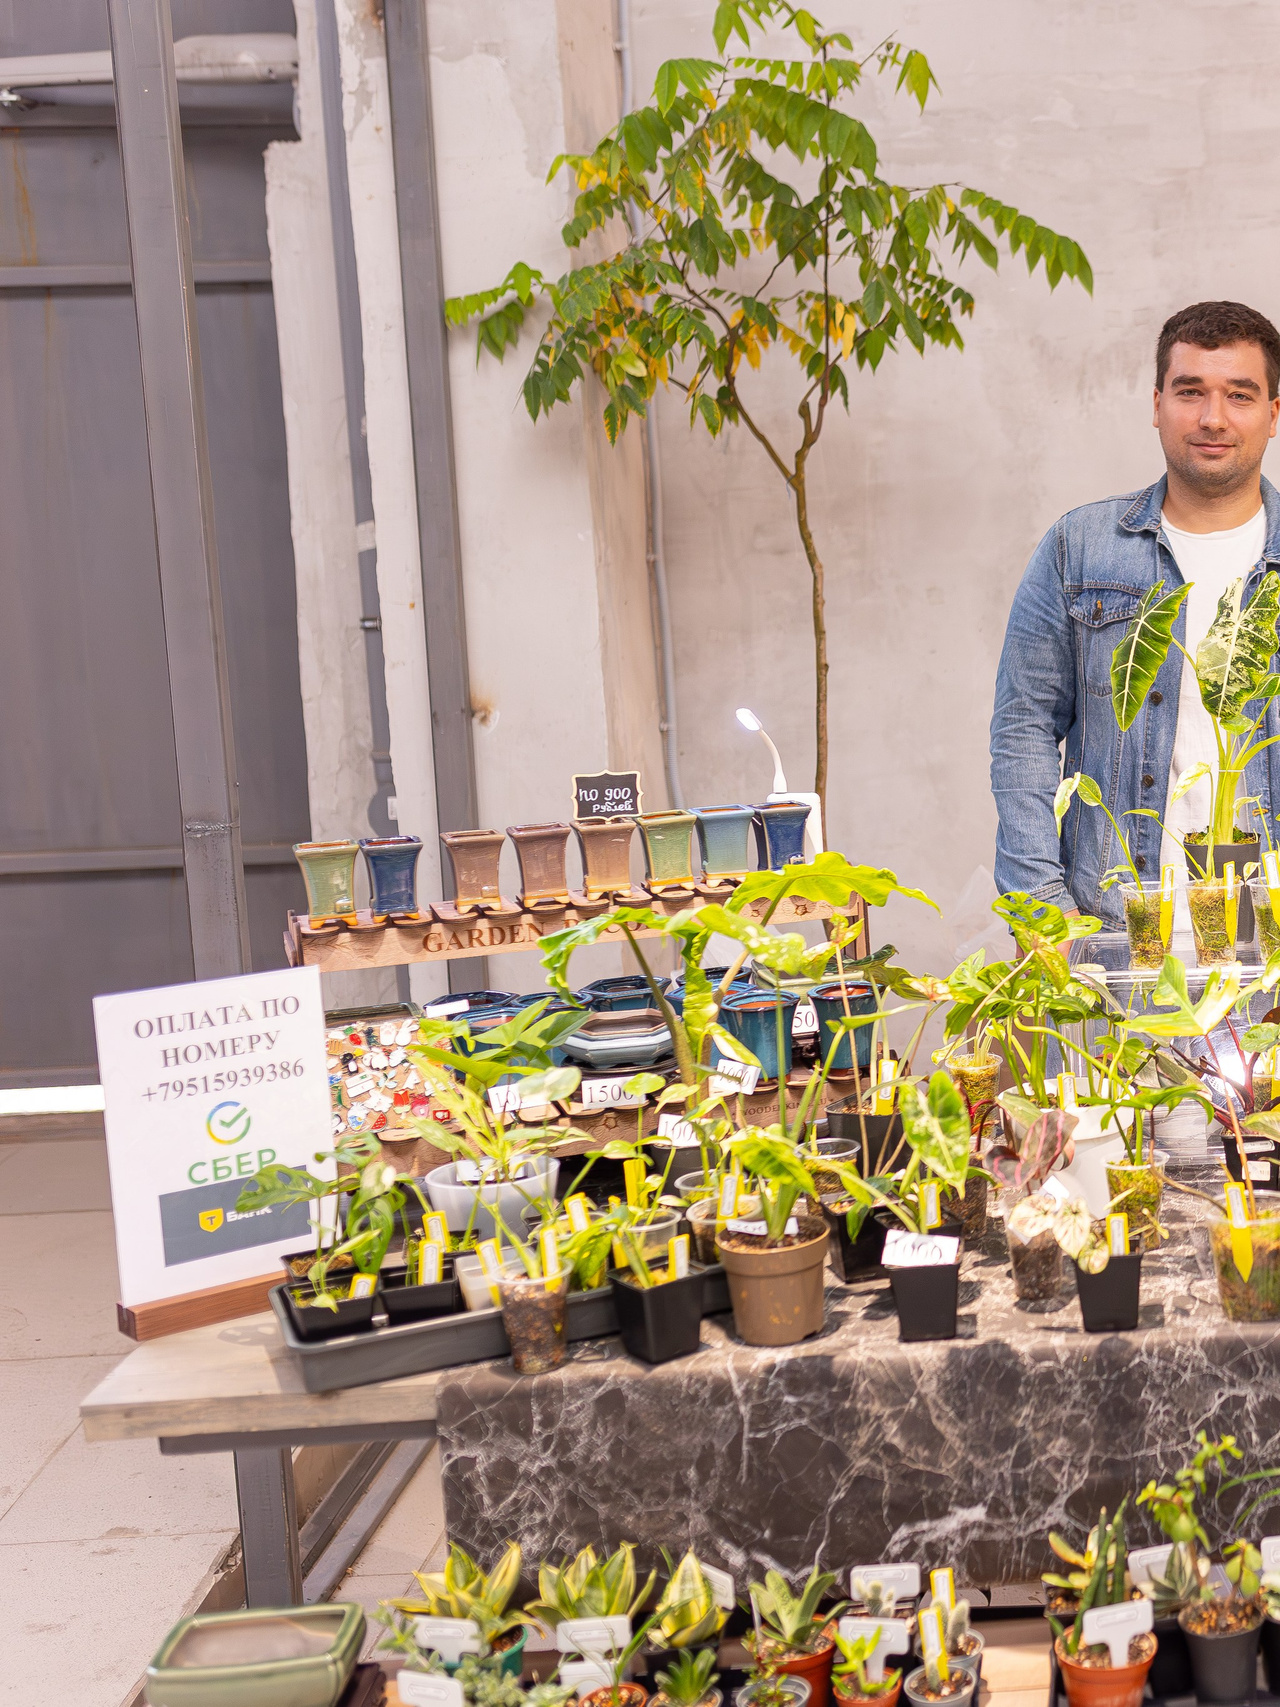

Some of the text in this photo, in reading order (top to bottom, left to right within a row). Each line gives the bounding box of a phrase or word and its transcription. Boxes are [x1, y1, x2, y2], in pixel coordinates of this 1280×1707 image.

[604, 787, 632, 801] 900
[422, 921, 545, 954] GARDEN
[133, 995, 300, 1039] ОПЛАТА ПО
[161, 1029, 281, 1069] НОМЕРУ
[141, 1057, 305, 1102] +79515939386
[187, 1148, 277, 1185] СБЕР
